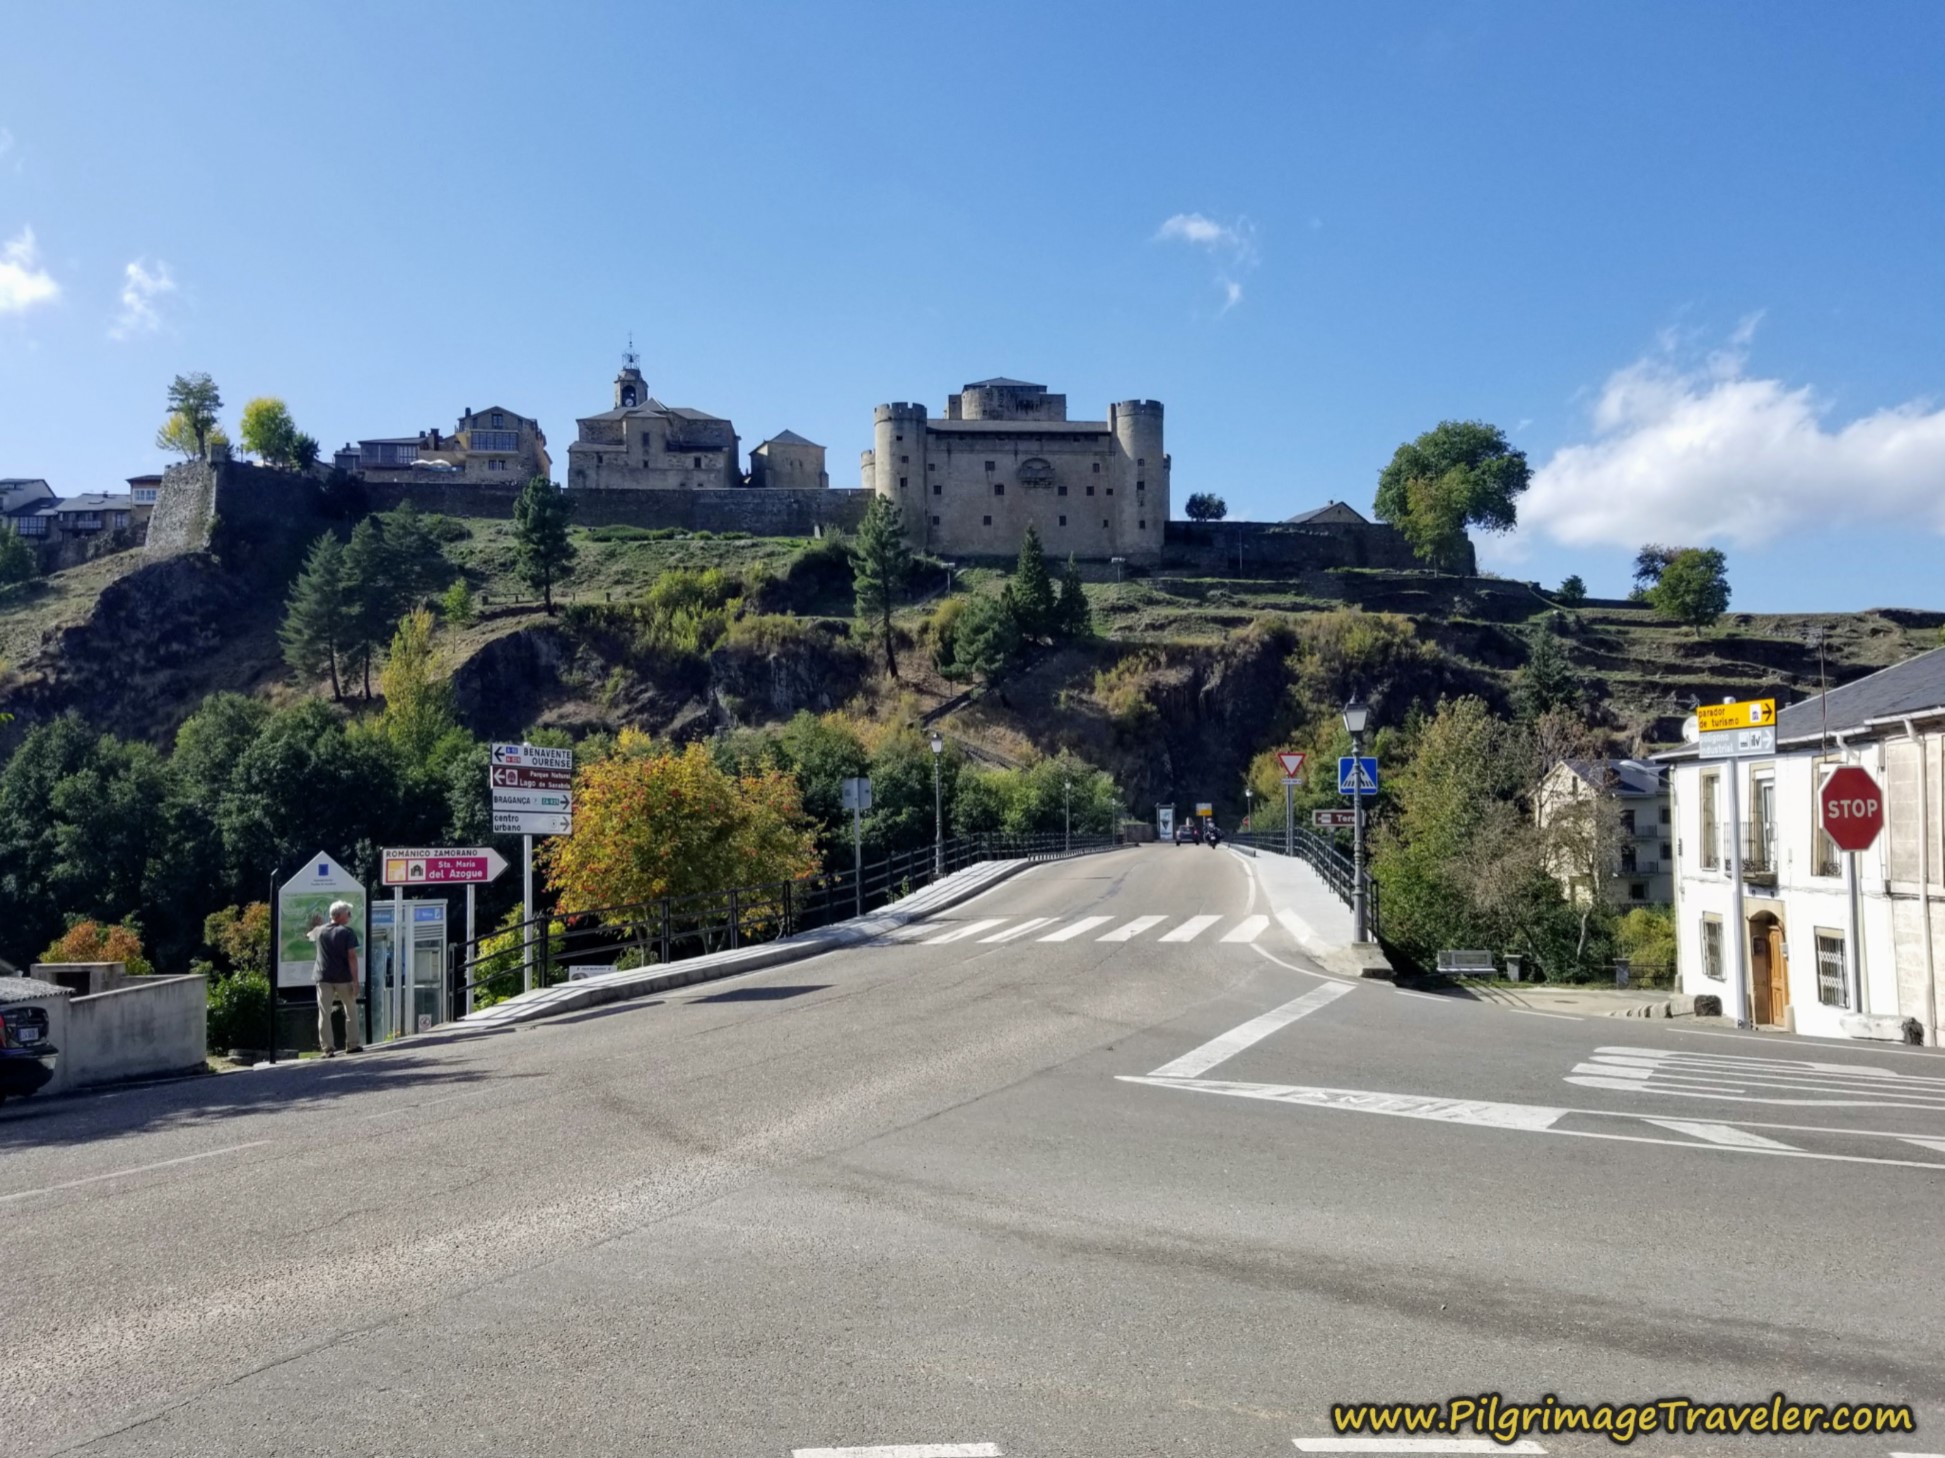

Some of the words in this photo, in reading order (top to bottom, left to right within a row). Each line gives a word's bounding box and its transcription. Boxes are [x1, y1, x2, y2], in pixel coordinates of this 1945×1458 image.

[1699, 708, 1725, 718] parador
[1700, 720, 1707, 728] de
[1711, 717, 1739, 727] turismo
[524, 747, 571, 759] BENAVENTE
[532, 757, 571, 768] OURENSE
[530, 770, 549, 779] Parque
[520, 780, 536, 788] Lago
[493, 795, 530, 805] BRAGANÇA
[1828, 799, 1878, 819] STOP
[494, 814, 519, 822] centro
[494, 823, 521, 832] urbano
[434, 849, 478, 857] ZAMORANO
[429, 870, 444, 878] del
[449, 869, 482, 880] Azogue
